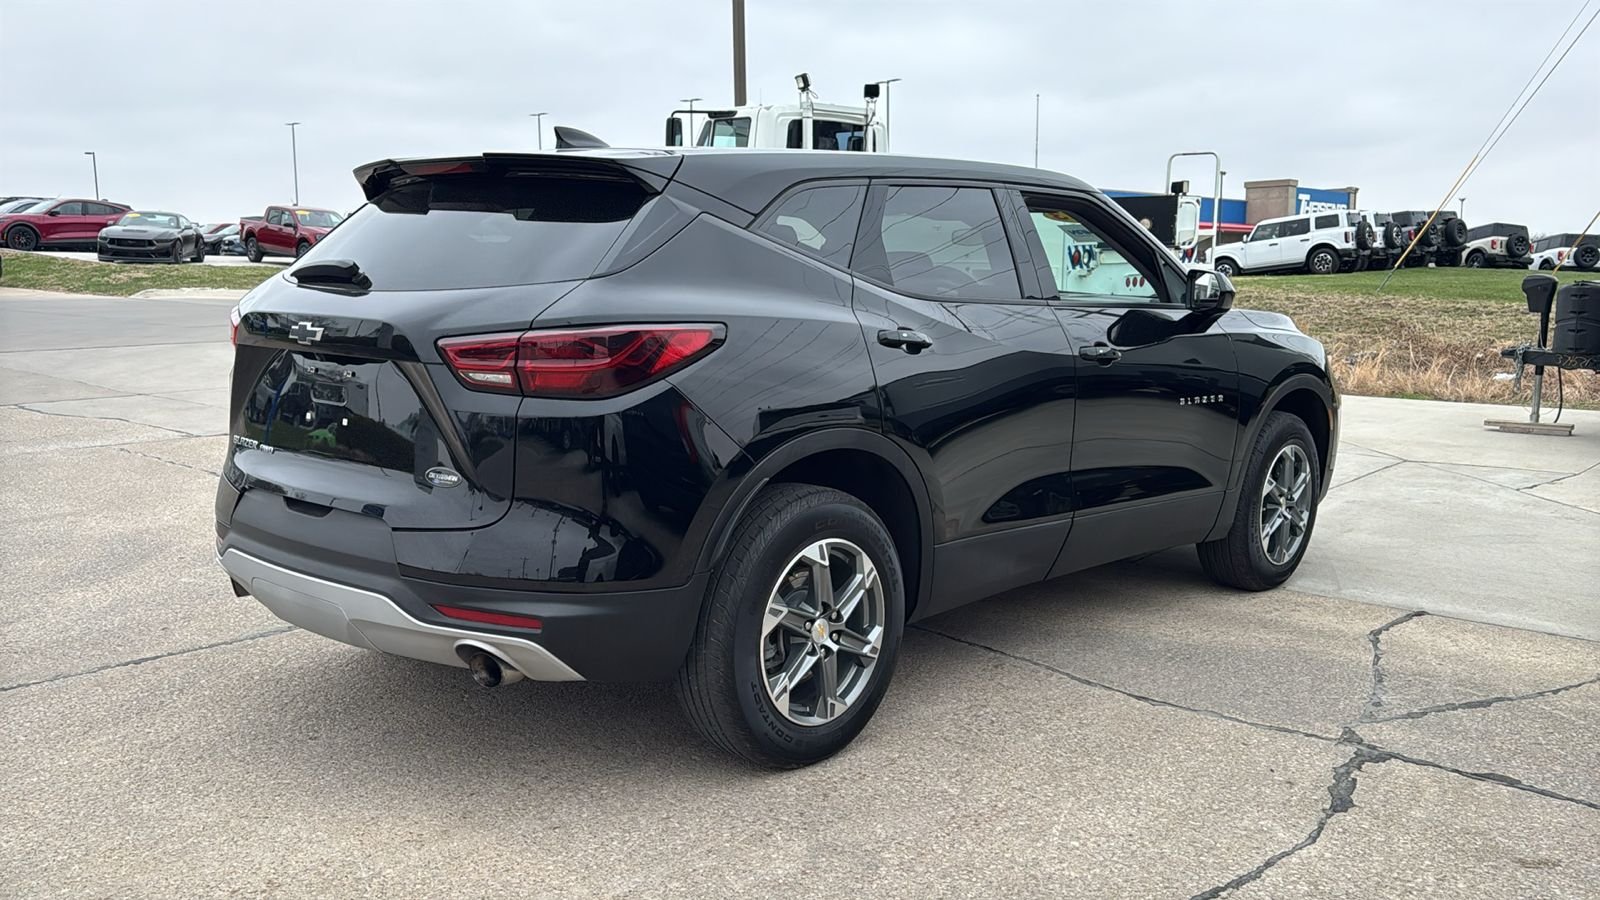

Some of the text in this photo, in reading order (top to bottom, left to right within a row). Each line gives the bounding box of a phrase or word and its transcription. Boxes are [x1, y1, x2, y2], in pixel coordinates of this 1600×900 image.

[1179, 394, 1224, 406] BLAZER
[233, 434, 258, 449] BLAZER
[751, 681, 794, 744] CONTACT
